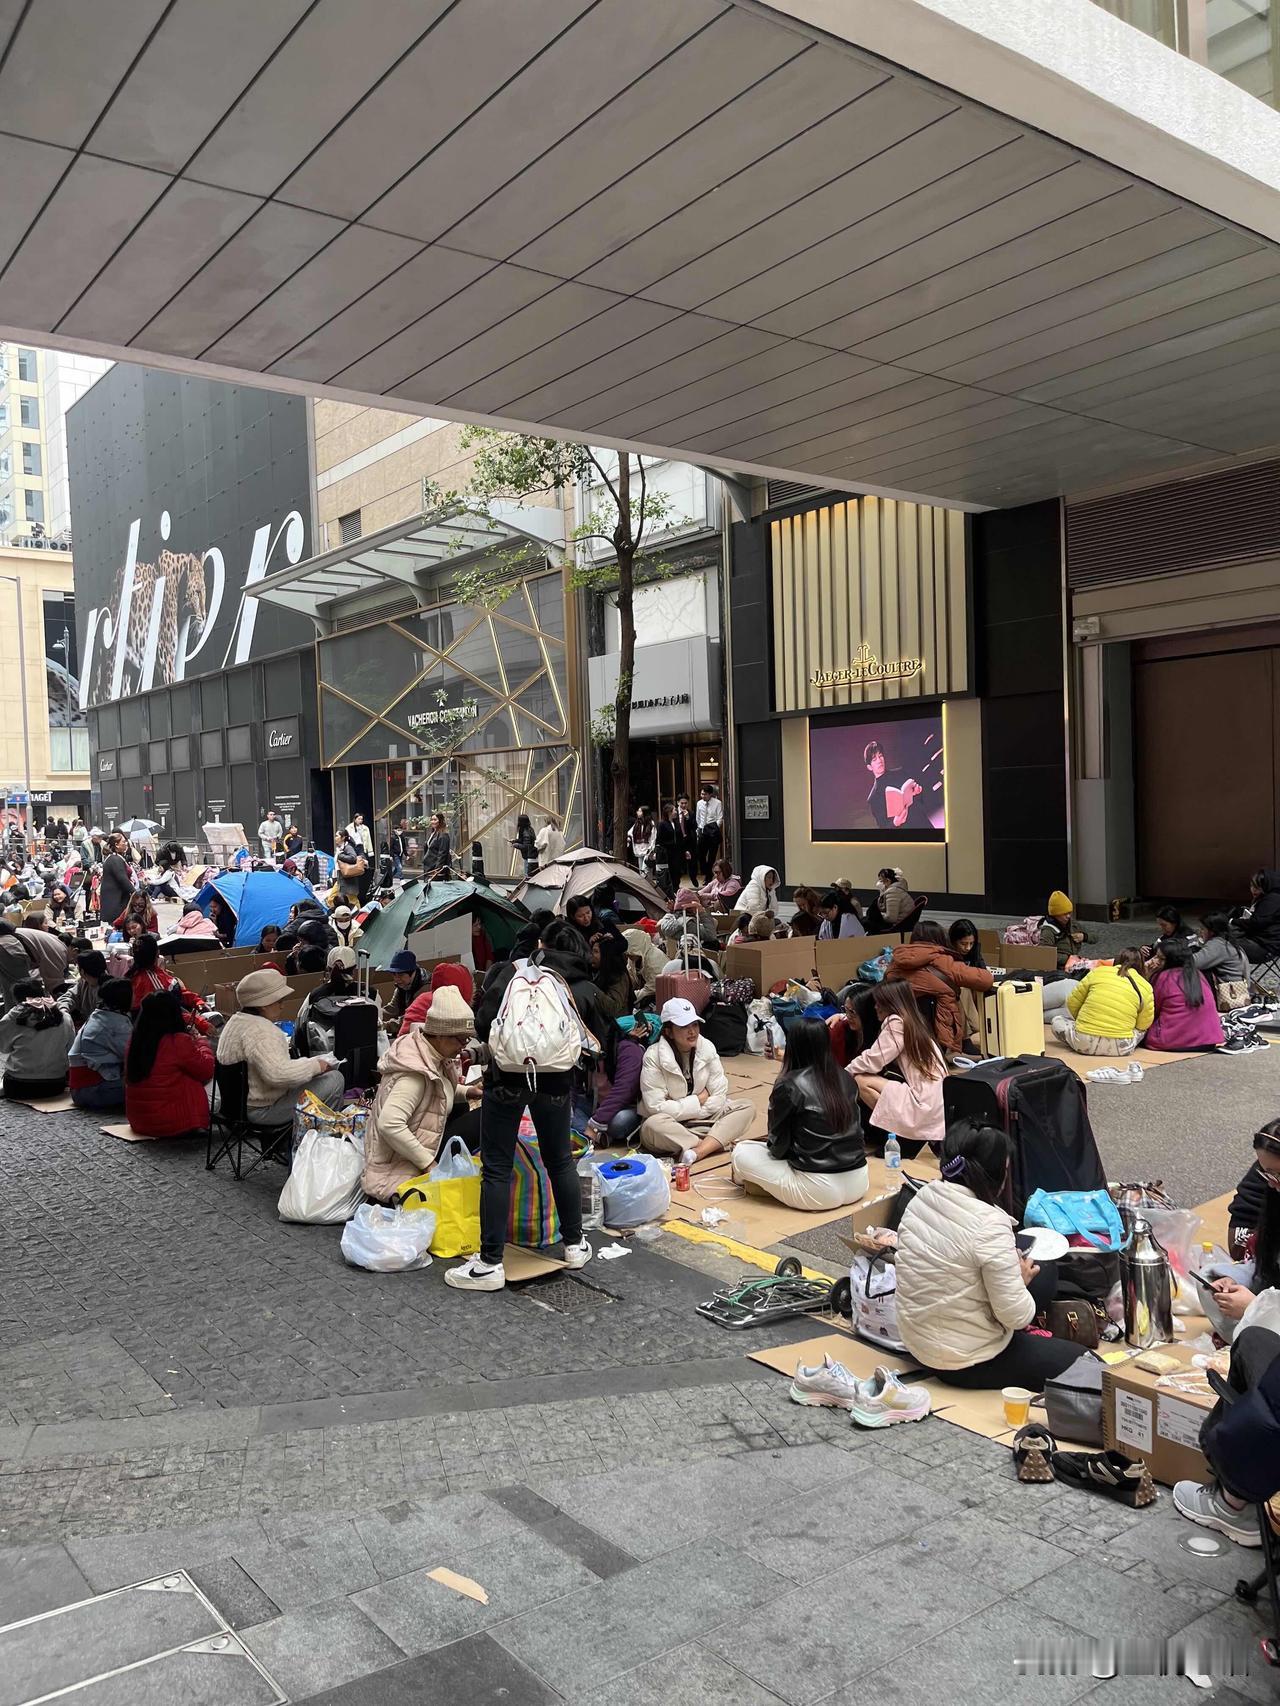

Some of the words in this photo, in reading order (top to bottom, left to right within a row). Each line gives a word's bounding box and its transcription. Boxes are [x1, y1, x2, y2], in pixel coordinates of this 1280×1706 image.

[407, 710, 438, 727] VACHERON
[269, 730, 293, 748] Cartier
[30, 791, 53, 802] IAGET
